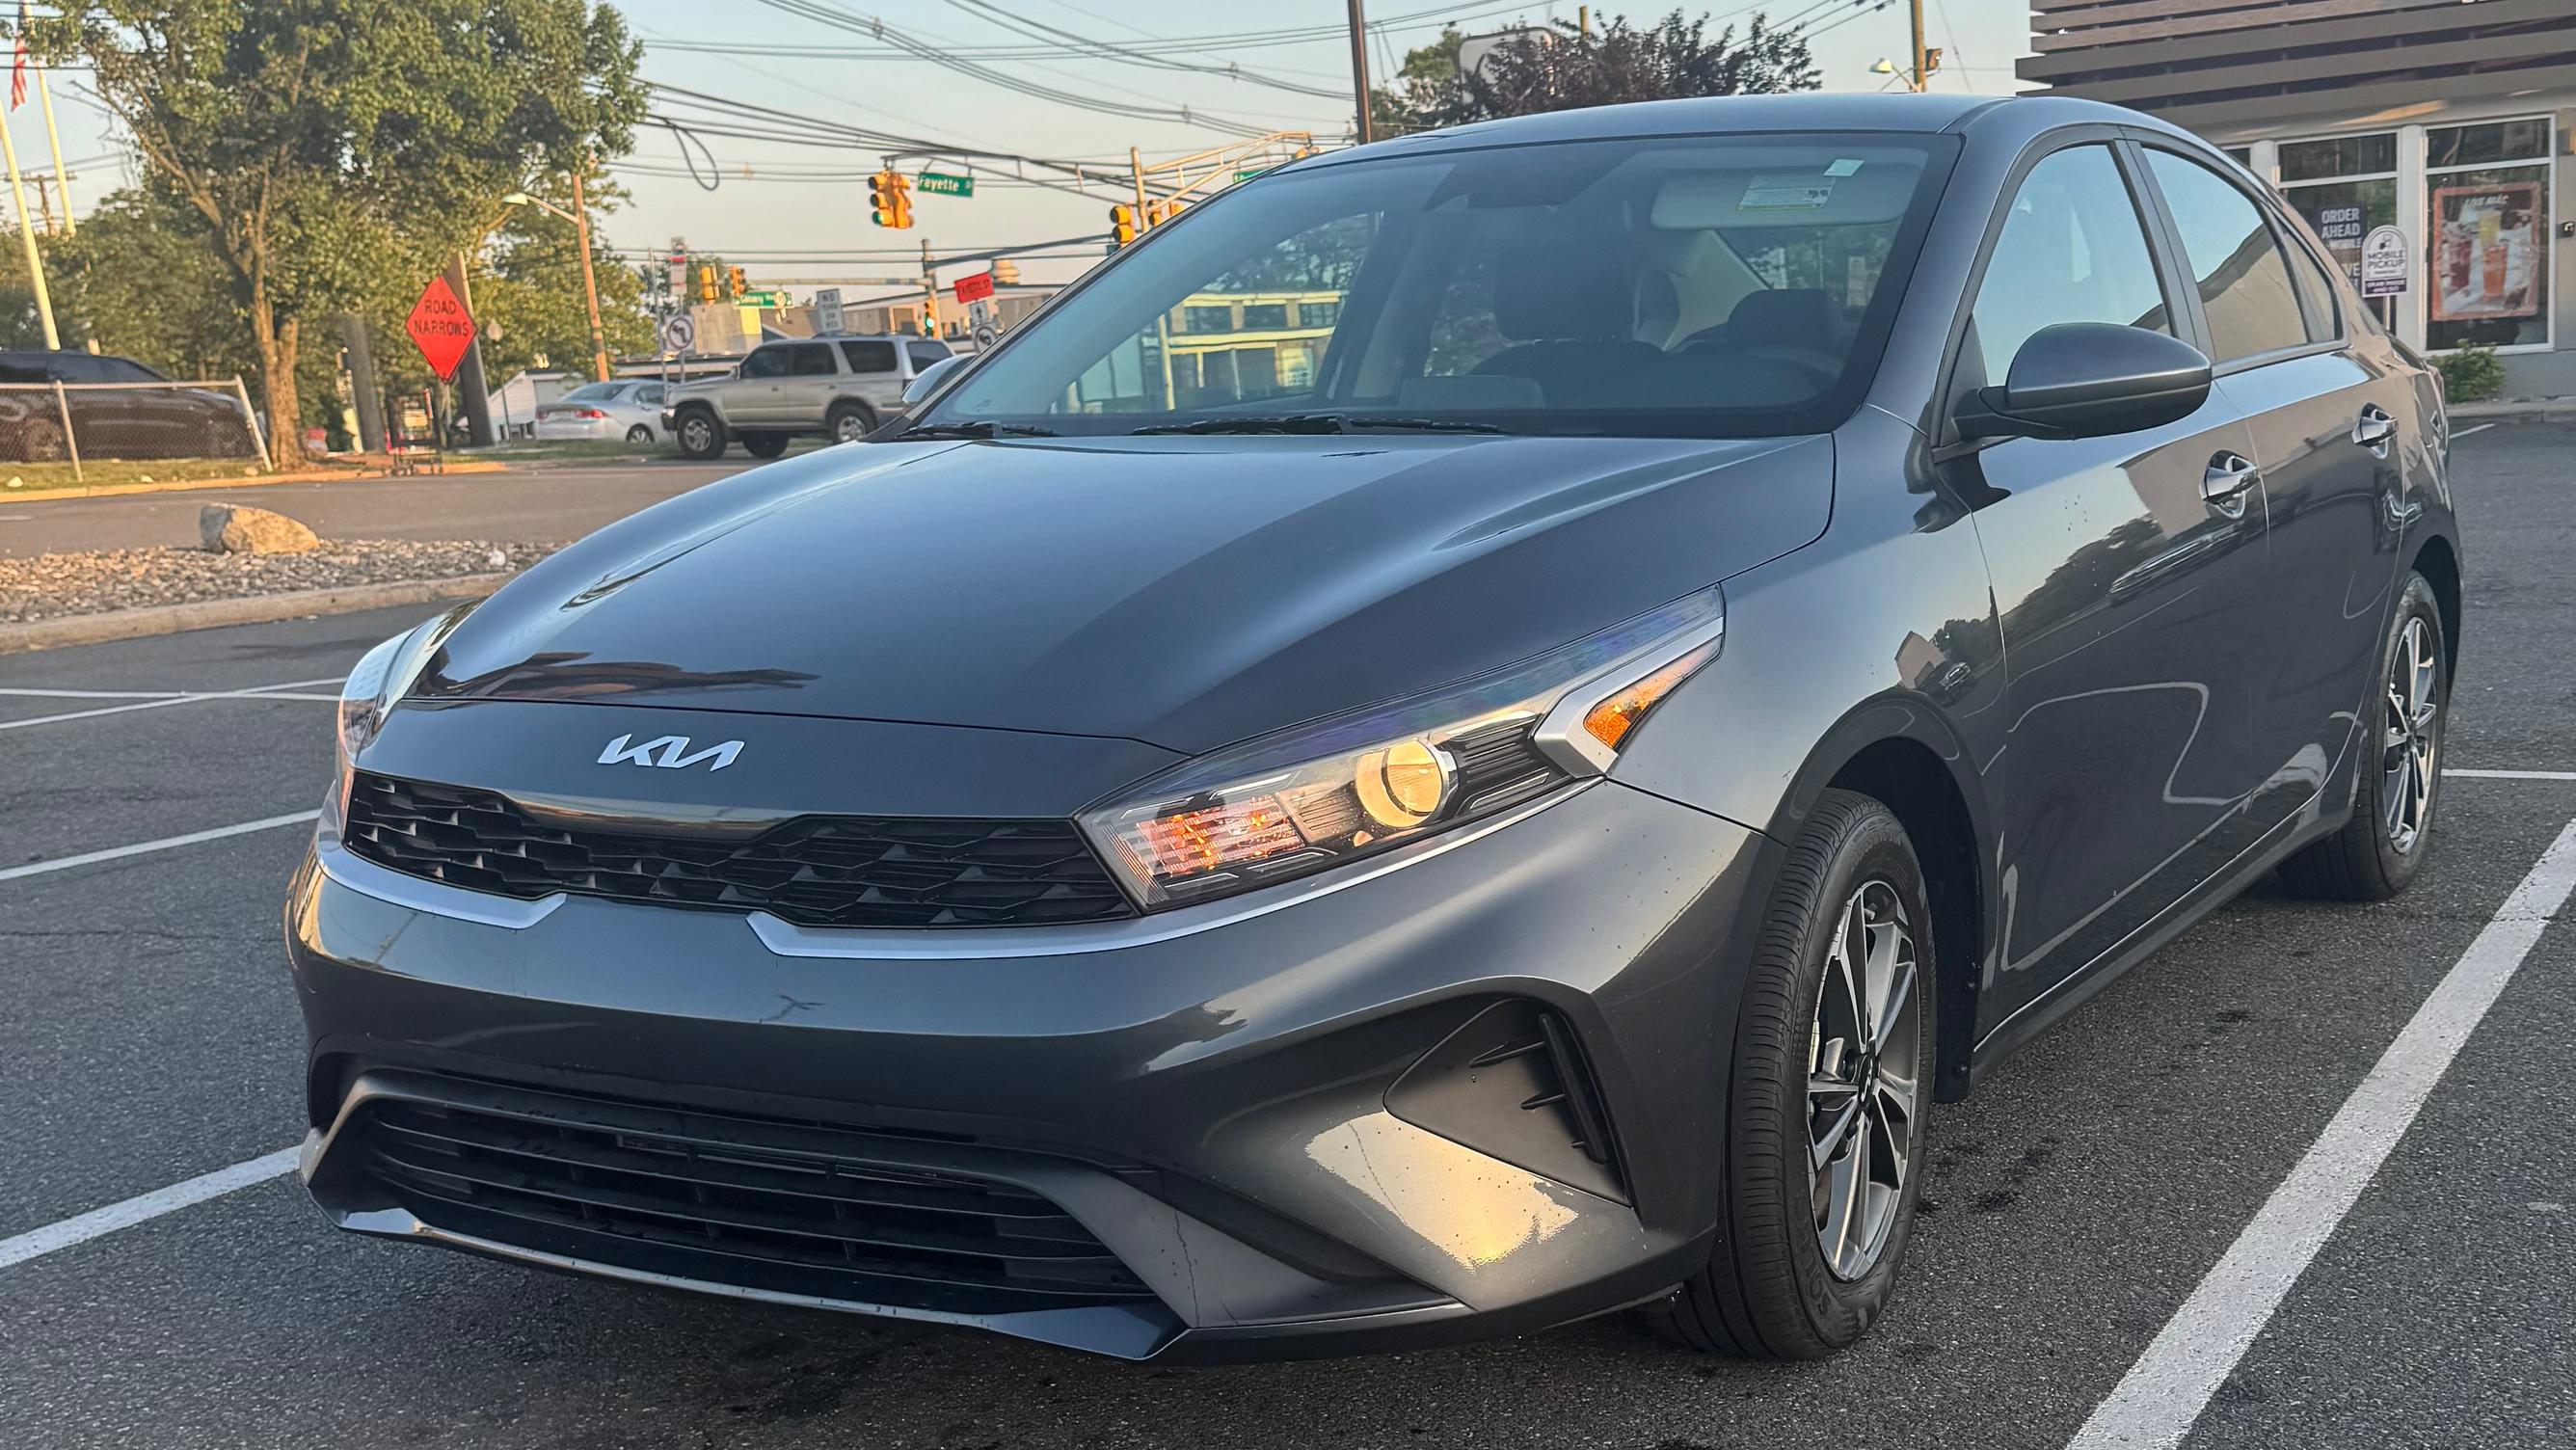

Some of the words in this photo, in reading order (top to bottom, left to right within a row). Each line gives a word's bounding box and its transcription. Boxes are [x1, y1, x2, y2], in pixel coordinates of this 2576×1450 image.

[920, 175, 959, 191] Fayette
[2321, 207, 2360, 224] ORDER
[2321, 223, 2361, 239] AHEAD
[2367, 250, 2404, 259] MOBILE
[2368, 259, 2405, 269] PICKUP
[821, 292, 836, 302] NO
[424, 299, 457, 315] ROAD
[414, 319, 470, 337] NARROWS
[597, 733, 745, 772] KIA
